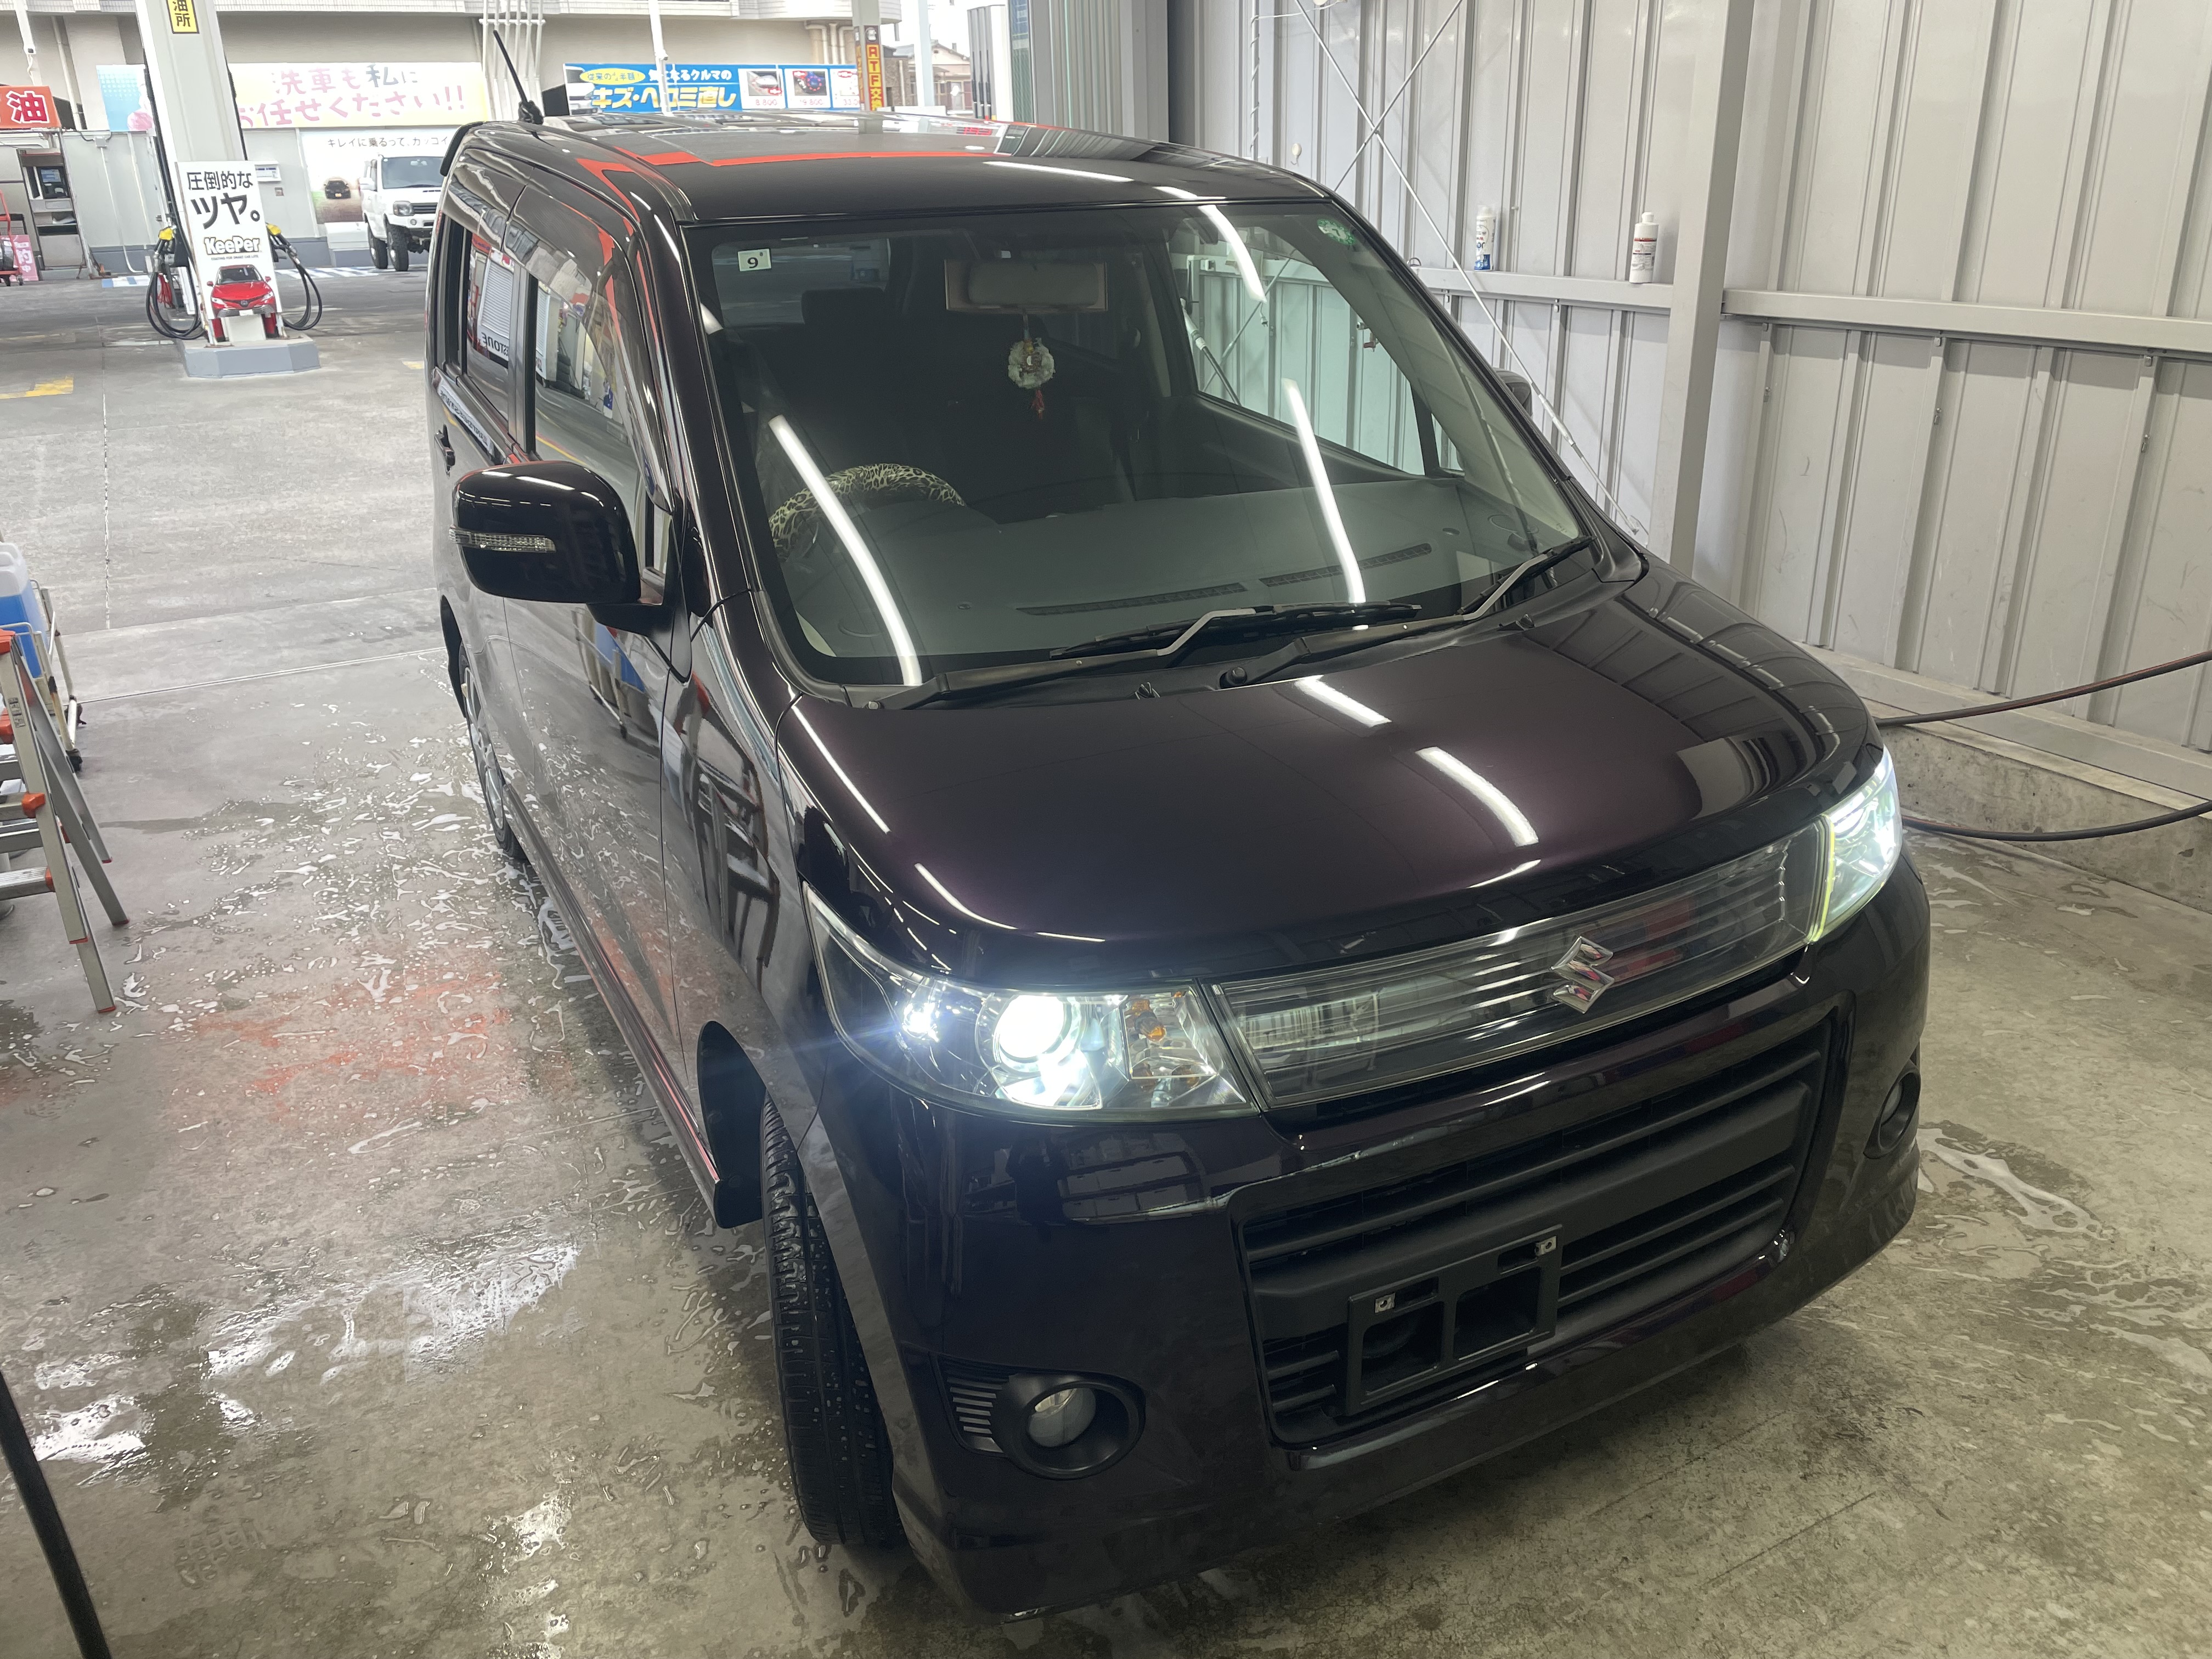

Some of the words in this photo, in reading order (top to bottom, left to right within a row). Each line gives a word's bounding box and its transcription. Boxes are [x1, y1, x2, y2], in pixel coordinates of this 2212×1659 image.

[173, 0, 191, 27] 油所
[271, 63, 419, 95] 洗車も私に
[187, 171, 253, 190] 圧倒的な
[190, 193, 260, 229] ツヤ。
[204, 235, 260, 255] KeePer
[747, 257, 758, 268] 9
